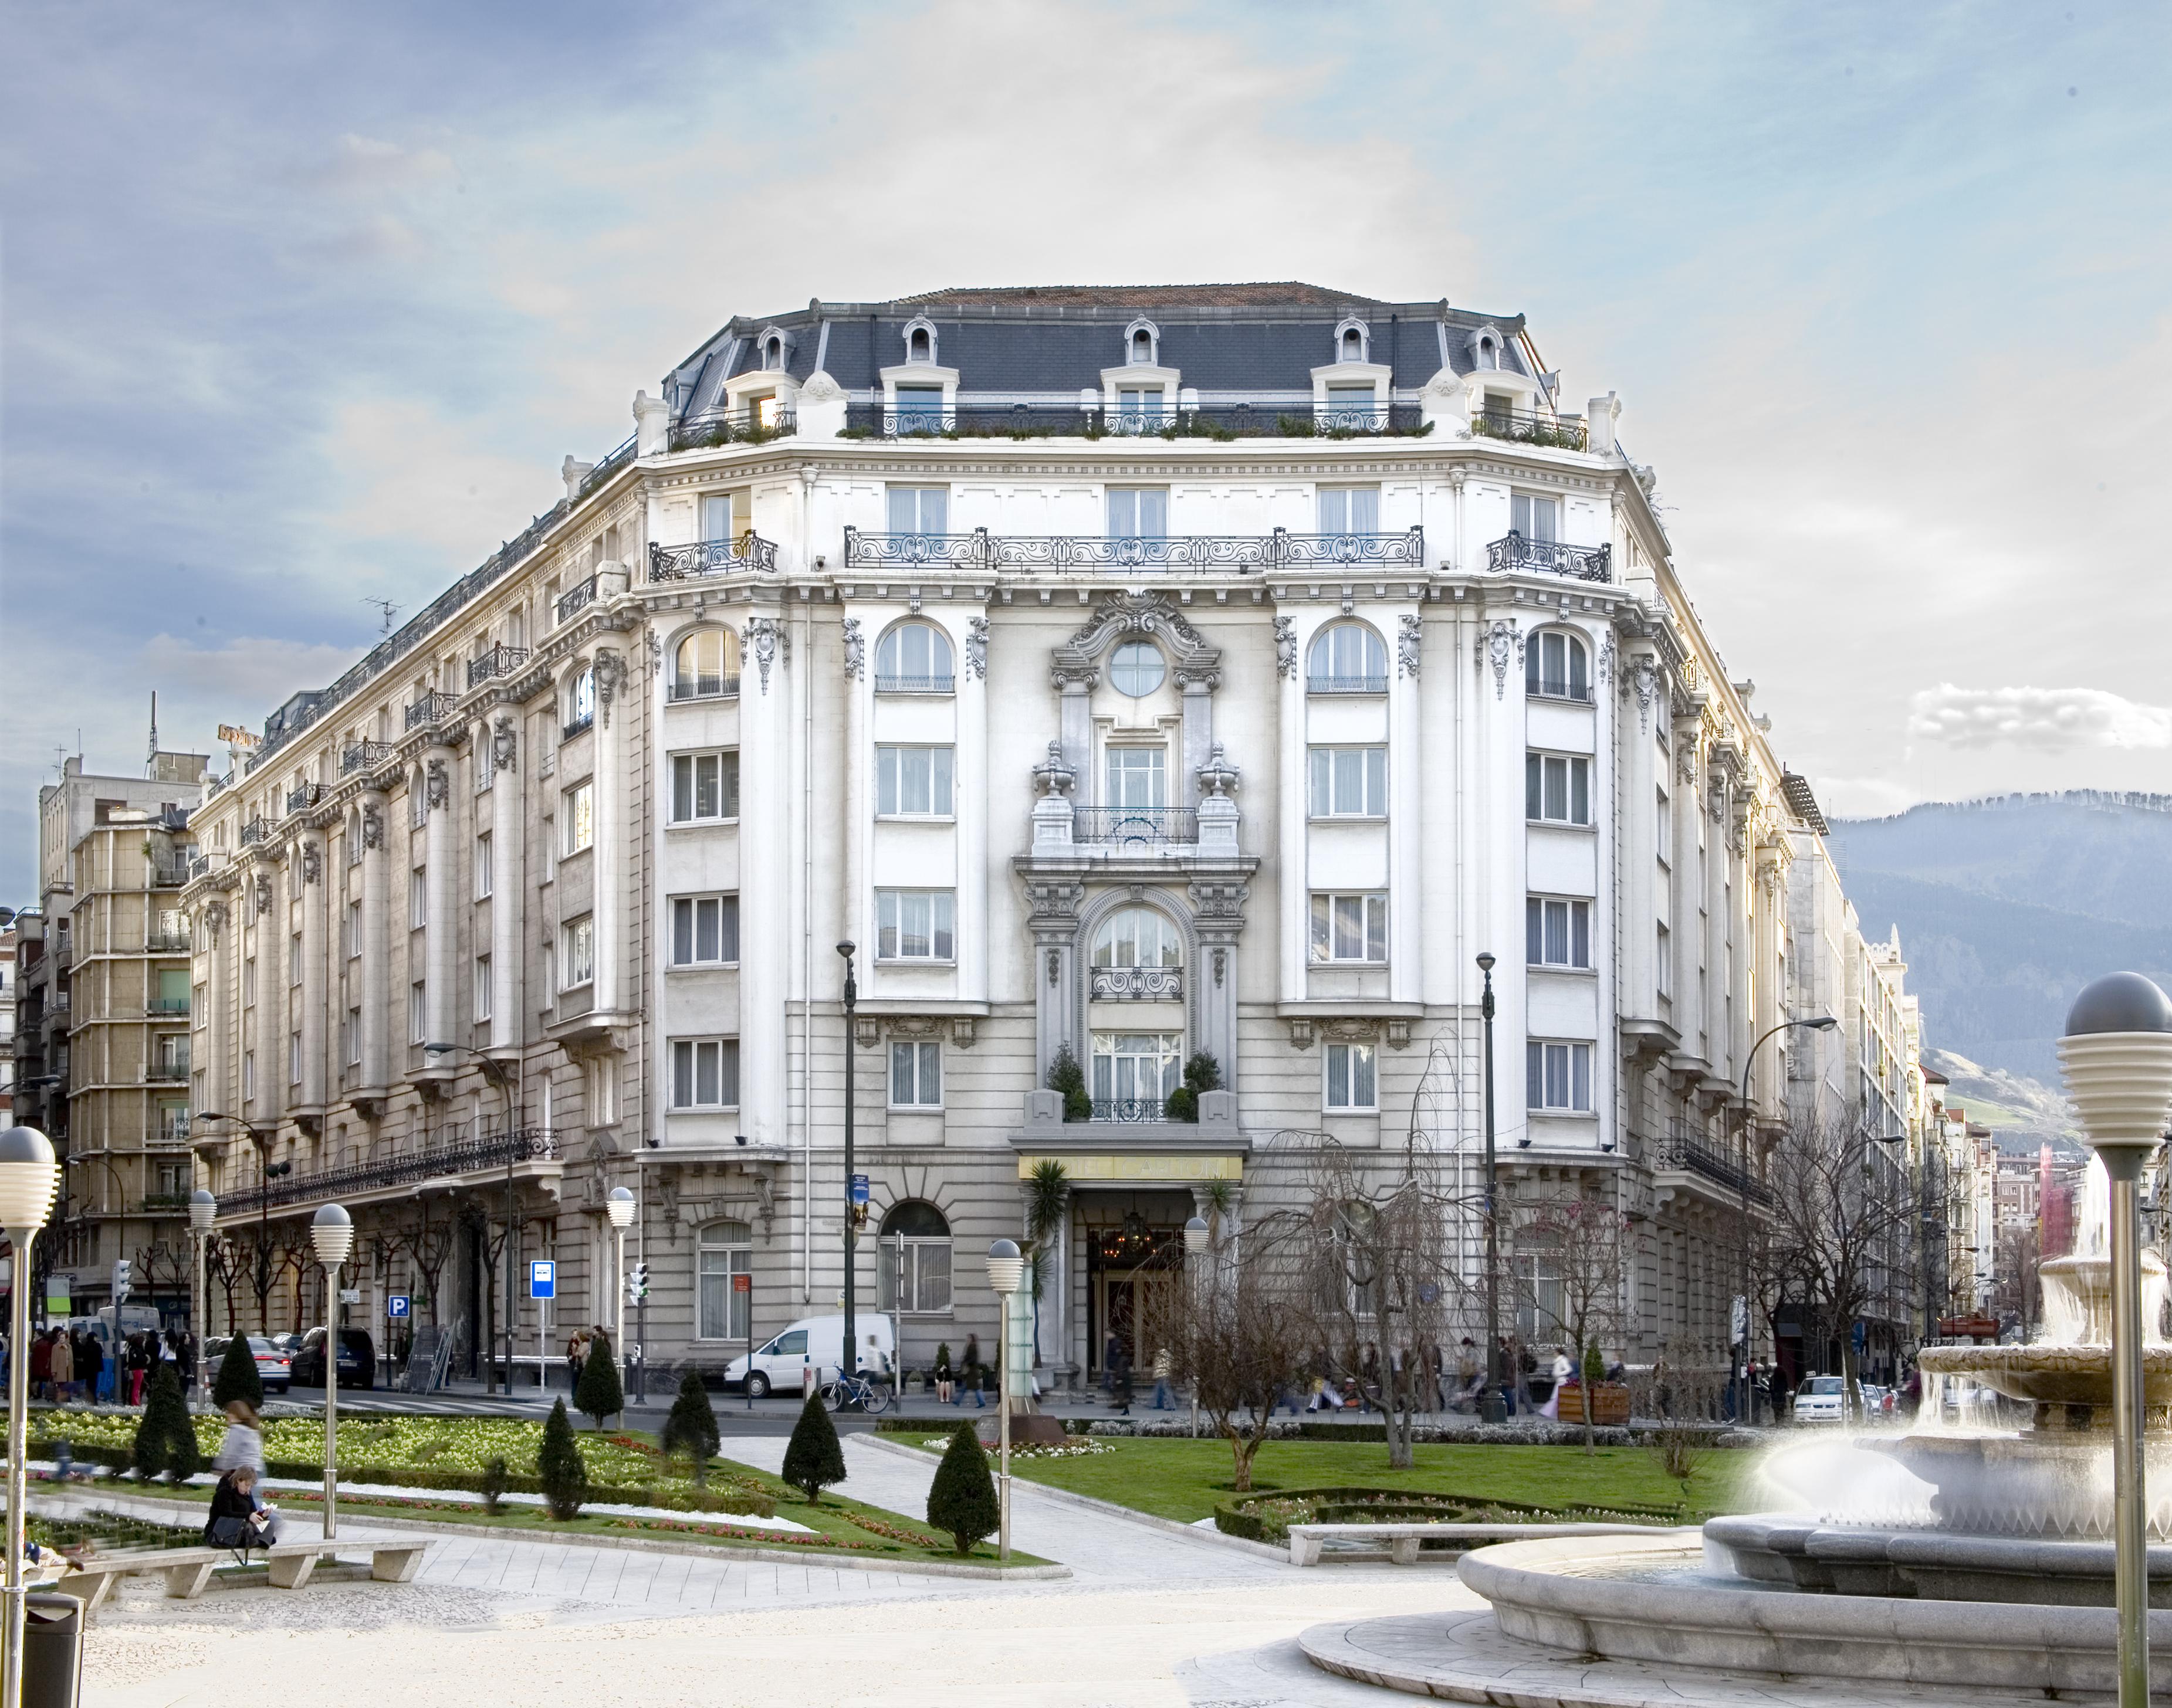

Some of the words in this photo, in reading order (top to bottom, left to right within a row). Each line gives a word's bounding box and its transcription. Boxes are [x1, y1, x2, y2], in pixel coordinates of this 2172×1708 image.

[1041, 1158, 1106, 1177] OTEL
[1121, 1158, 1220, 1177] CARLTON
[393, 1298, 405, 1314] P
